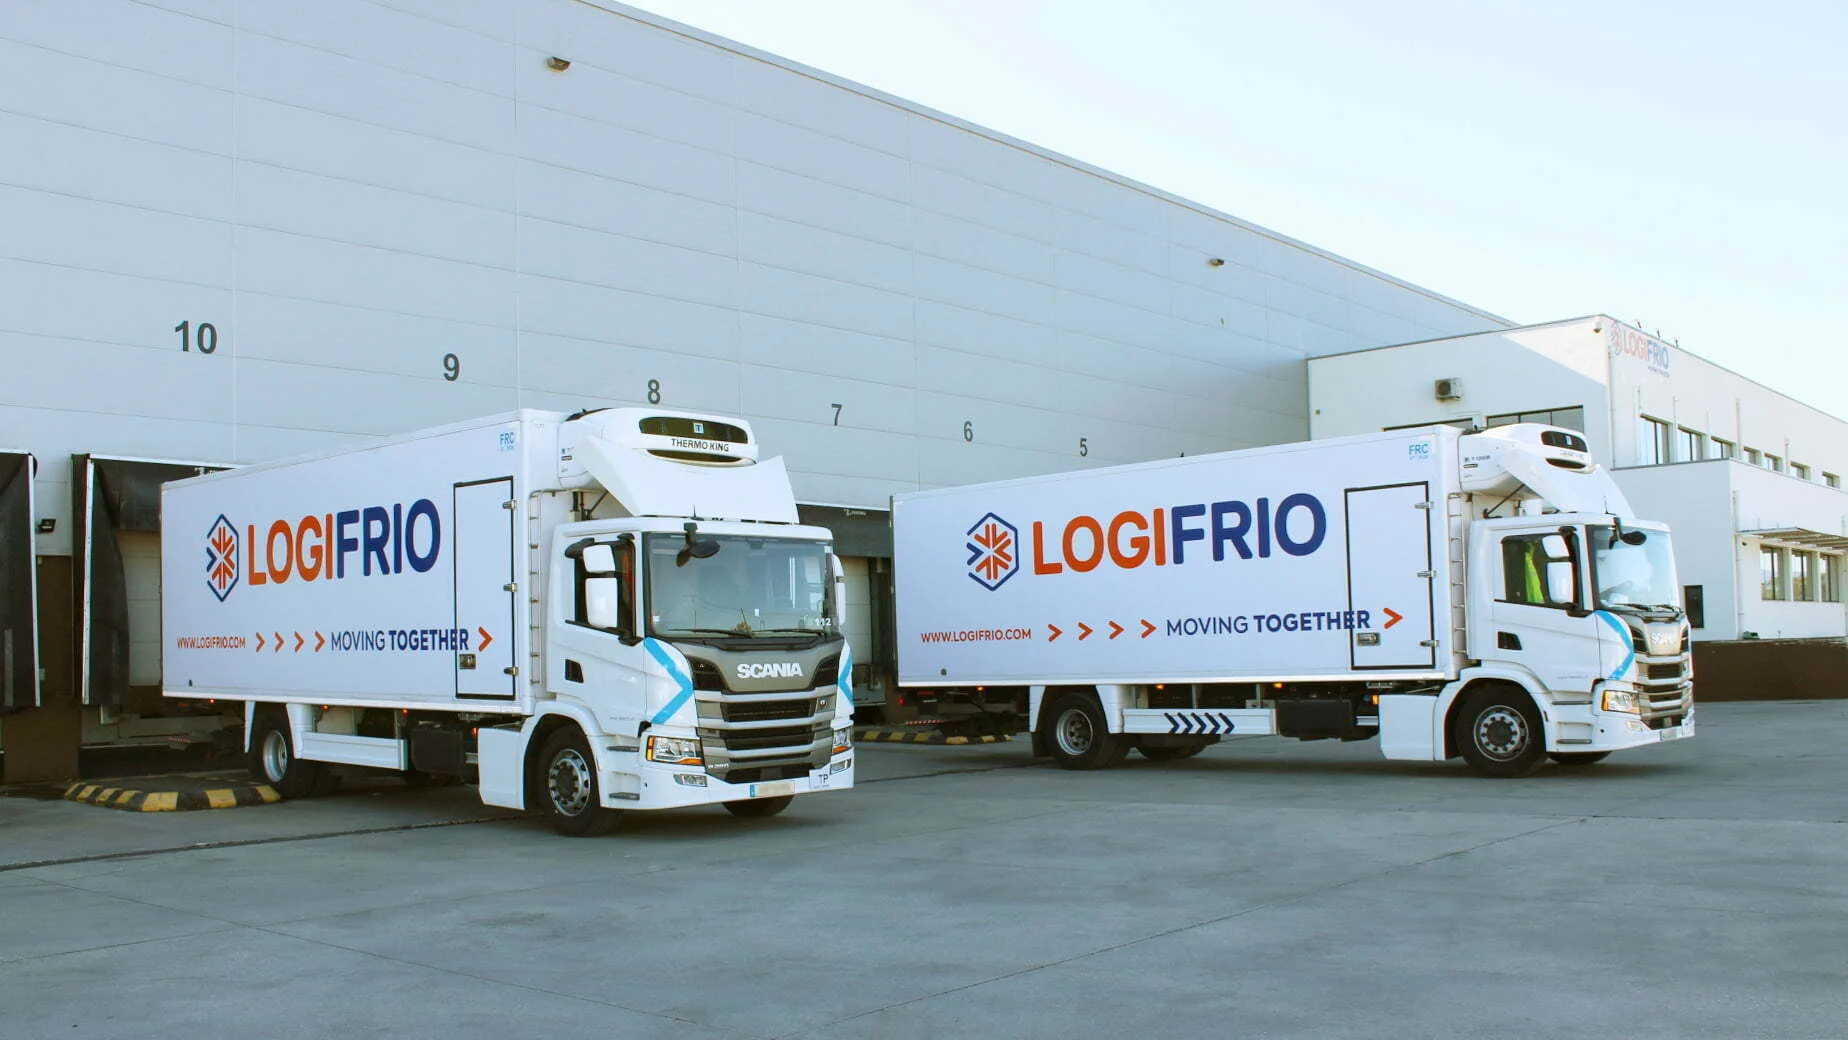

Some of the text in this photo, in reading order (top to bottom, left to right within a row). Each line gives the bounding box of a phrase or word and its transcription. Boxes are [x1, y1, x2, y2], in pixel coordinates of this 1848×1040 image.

[174, 320, 217, 354] 10
[443, 353, 460, 381] 9
[647, 379, 661, 404] 8
[831, 403, 842, 425] 7
[500, 432, 514, 444] FRC
[963, 421, 974, 442] 6
[671, 438, 729, 452] THERMO KING
[1079, 438, 1089, 457] 5
[1409, 444, 1428, 454] FRC
[248, 498, 441, 586] LOGIFRIO
[1033, 493, 1327, 575] LOGIFRIO
[1166, 610, 1370, 636] MOVING TOGETHER
[176, 636, 247, 649] WWW.LOGIFRIO.COM
[331, 628, 469, 651] MOVING TOGETHER
[920, 628, 1032, 643] WWW.LOGIFRIO.COM
[737, 662, 803, 679] SCANIA
